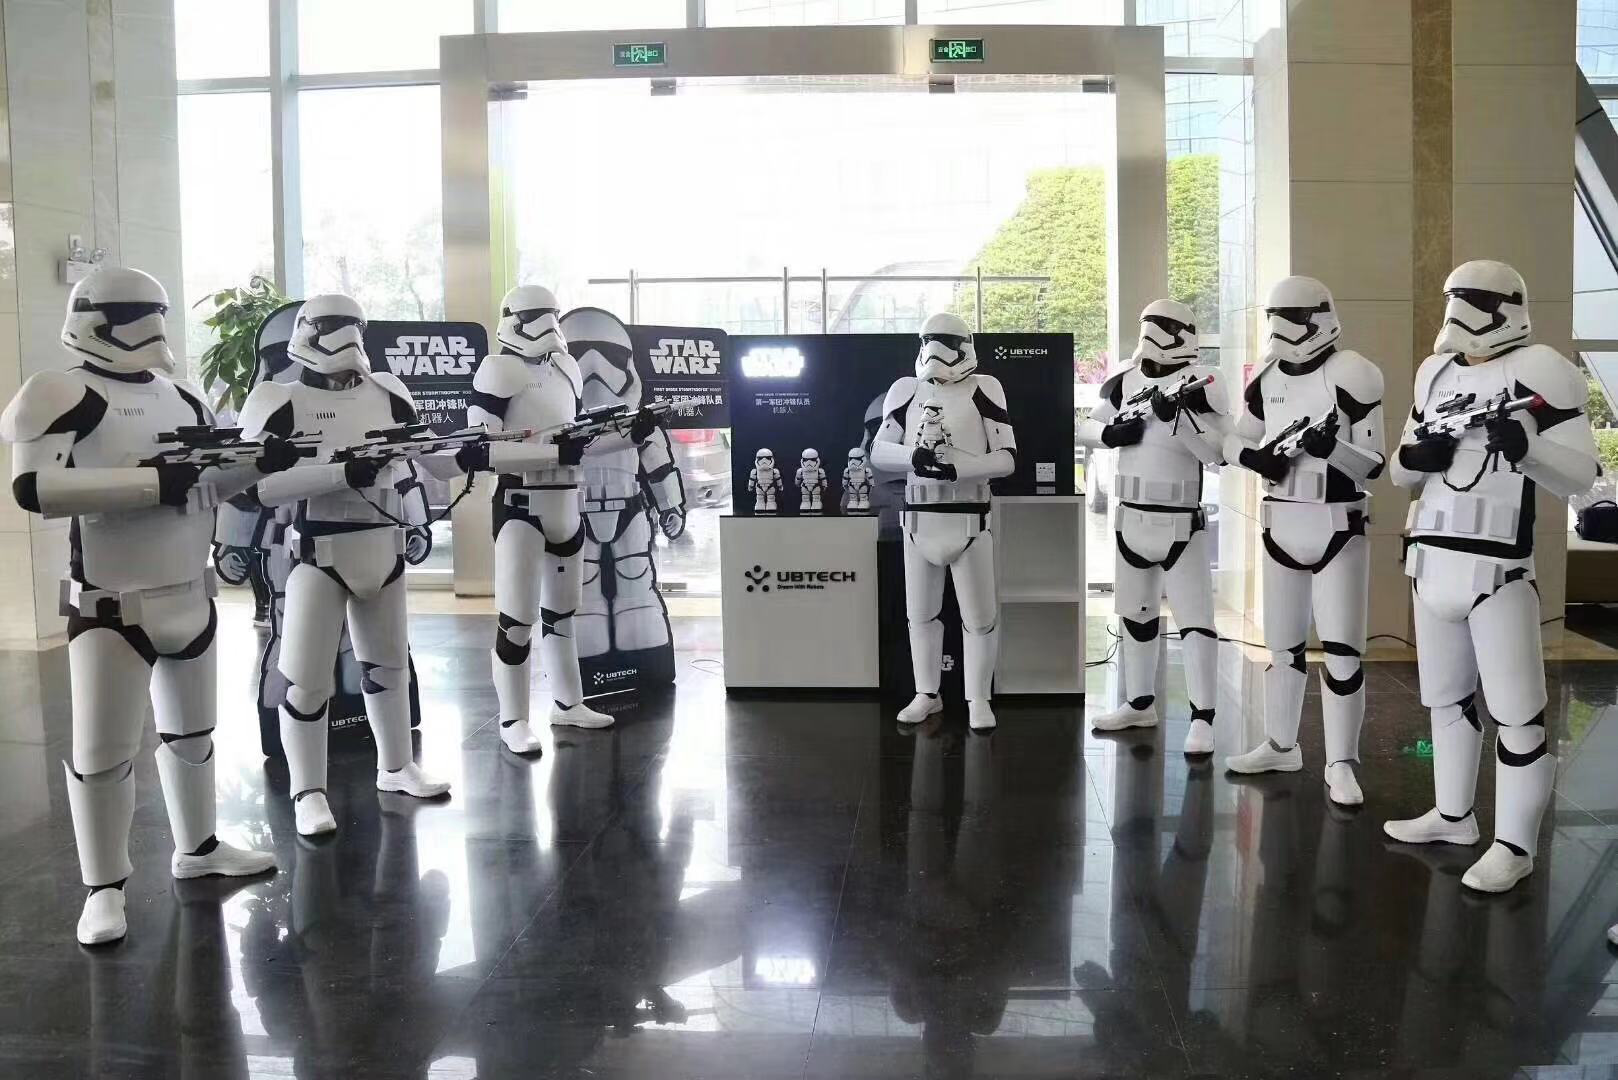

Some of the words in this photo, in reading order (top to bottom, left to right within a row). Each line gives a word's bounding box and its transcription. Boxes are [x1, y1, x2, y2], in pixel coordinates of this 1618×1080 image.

[384, 335, 475, 356] STAR
[649, 338, 720, 357] STAR
[385, 355, 476, 376] WARS
[650, 355, 721, 375] WARS
[777, 571, 856, 582] UBTECH
[606, 668, 638, 679] UBTECH
